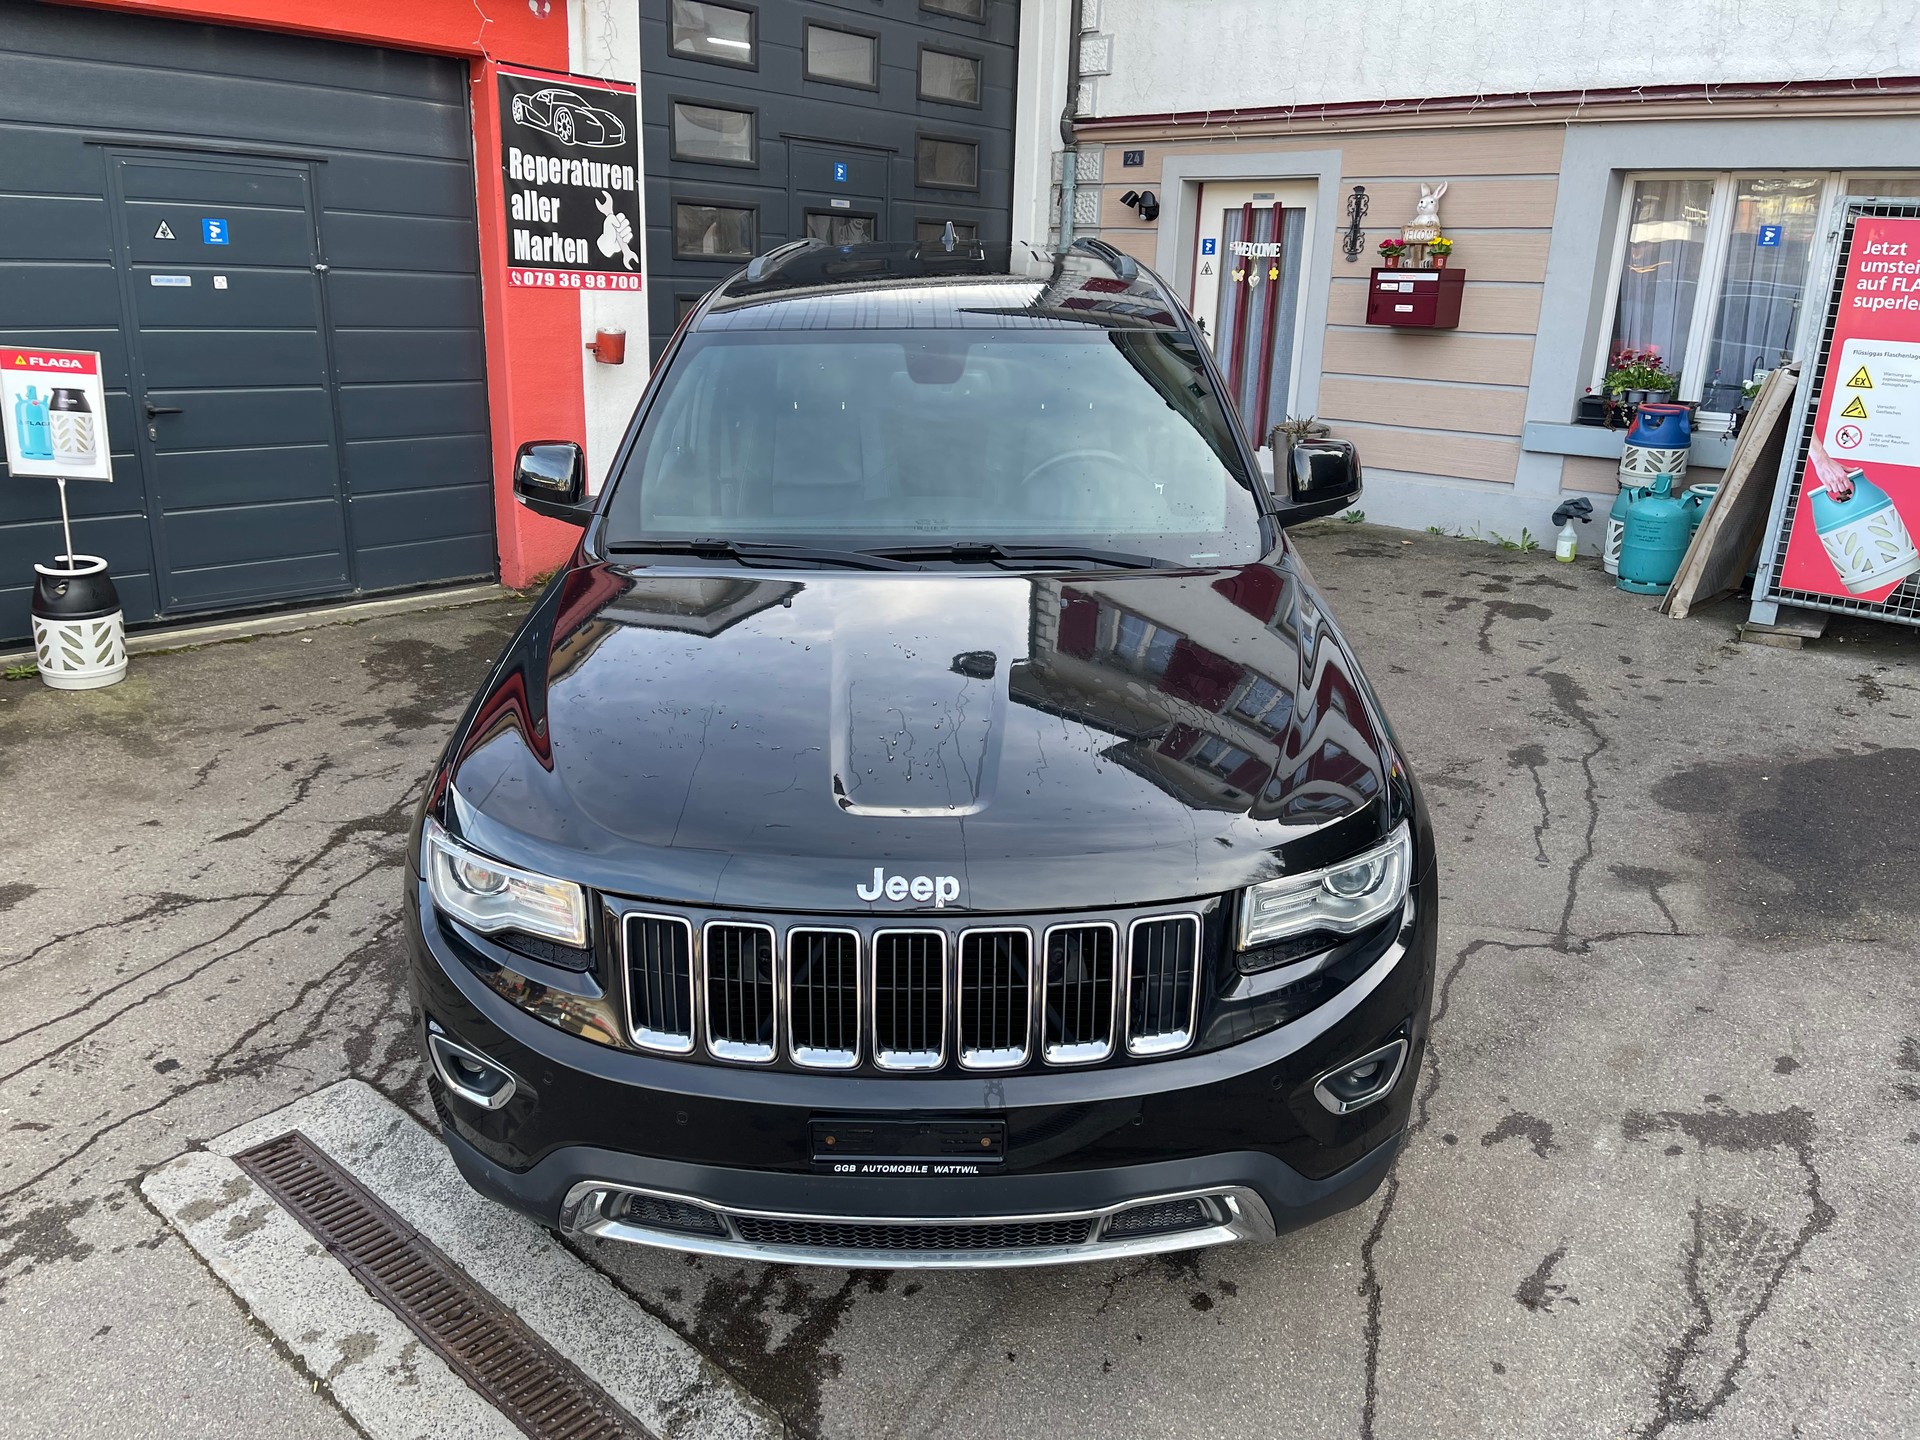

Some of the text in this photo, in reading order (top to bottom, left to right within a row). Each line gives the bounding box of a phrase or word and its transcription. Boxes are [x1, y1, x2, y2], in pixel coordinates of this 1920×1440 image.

[1127, 152, 1140, 165] 24
[509, 147, 634, 191] Reperaturen
[511, 190, 560, 223] aller
[513, 229, 589, 264] Marken
[1235, 241, 1281, 257] WELCOME
[1862, 240, 1908, 256] Jetzt
[1860, 259, 1920, 275] umstei
[523, 271, 639, 289] 079 36 98 700
[1856, 275, 1888, 291] auf
[29, 357, 83, 368] FLAGA
[1854, 377, 1867, 386] EX
[857, 867, 960, 909] Jeep
[834, 1164, 979, 1174] GGB AUTOMOBILE WATTWIL
